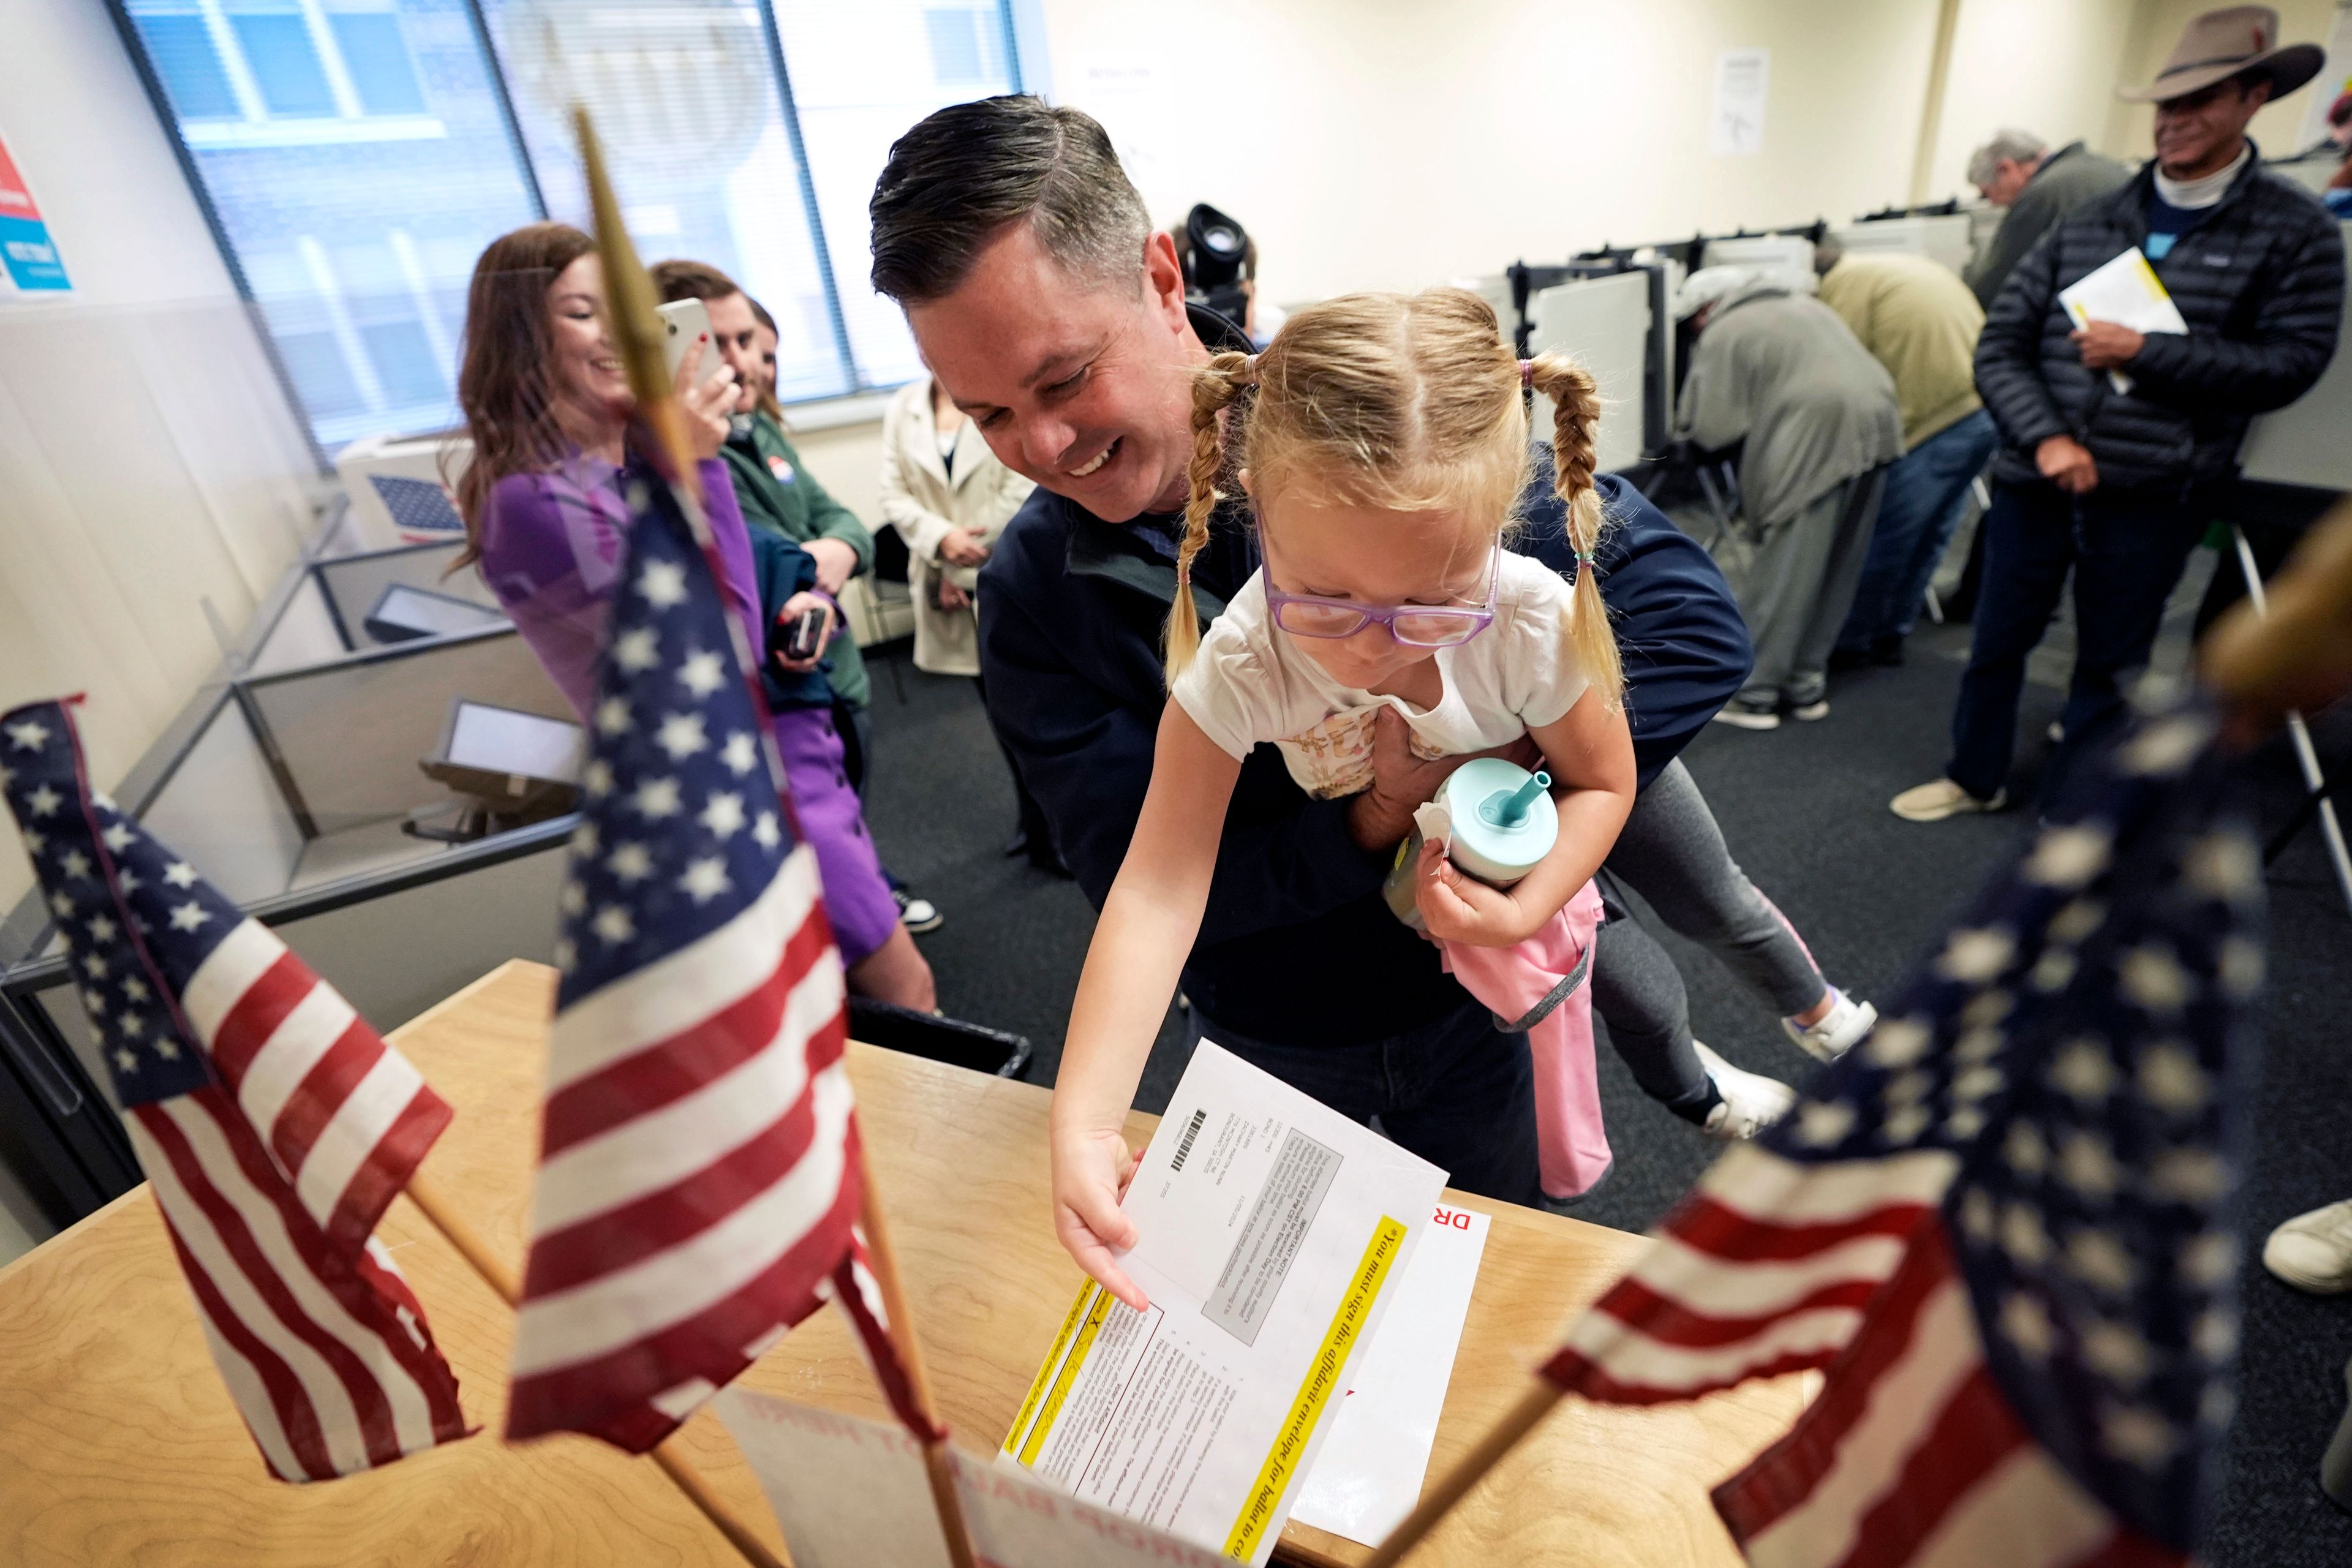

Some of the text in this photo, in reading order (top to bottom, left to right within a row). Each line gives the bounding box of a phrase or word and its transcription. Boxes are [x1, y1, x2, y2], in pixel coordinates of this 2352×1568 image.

[1285, 1218, 1307, 1257] IMPORTANT
[1359, 1259, 1379, 1293] must
[1345, 1292, 1363, 1322] sign
[1088, 1315, 1102, 1330] X
[1333, 1322, 1350, 1348] this
[1306, 1348, 1336, 1403] affidavit
[1094, 1404, 1110, 1434] Affidavit
[1279, 1403, 1310, 1461] envelope
[1268, 1457, 1284, 1485] for
[1249, 1484, 1274, 1524] ballot
[1242, 1522, 1254, 1538] to
